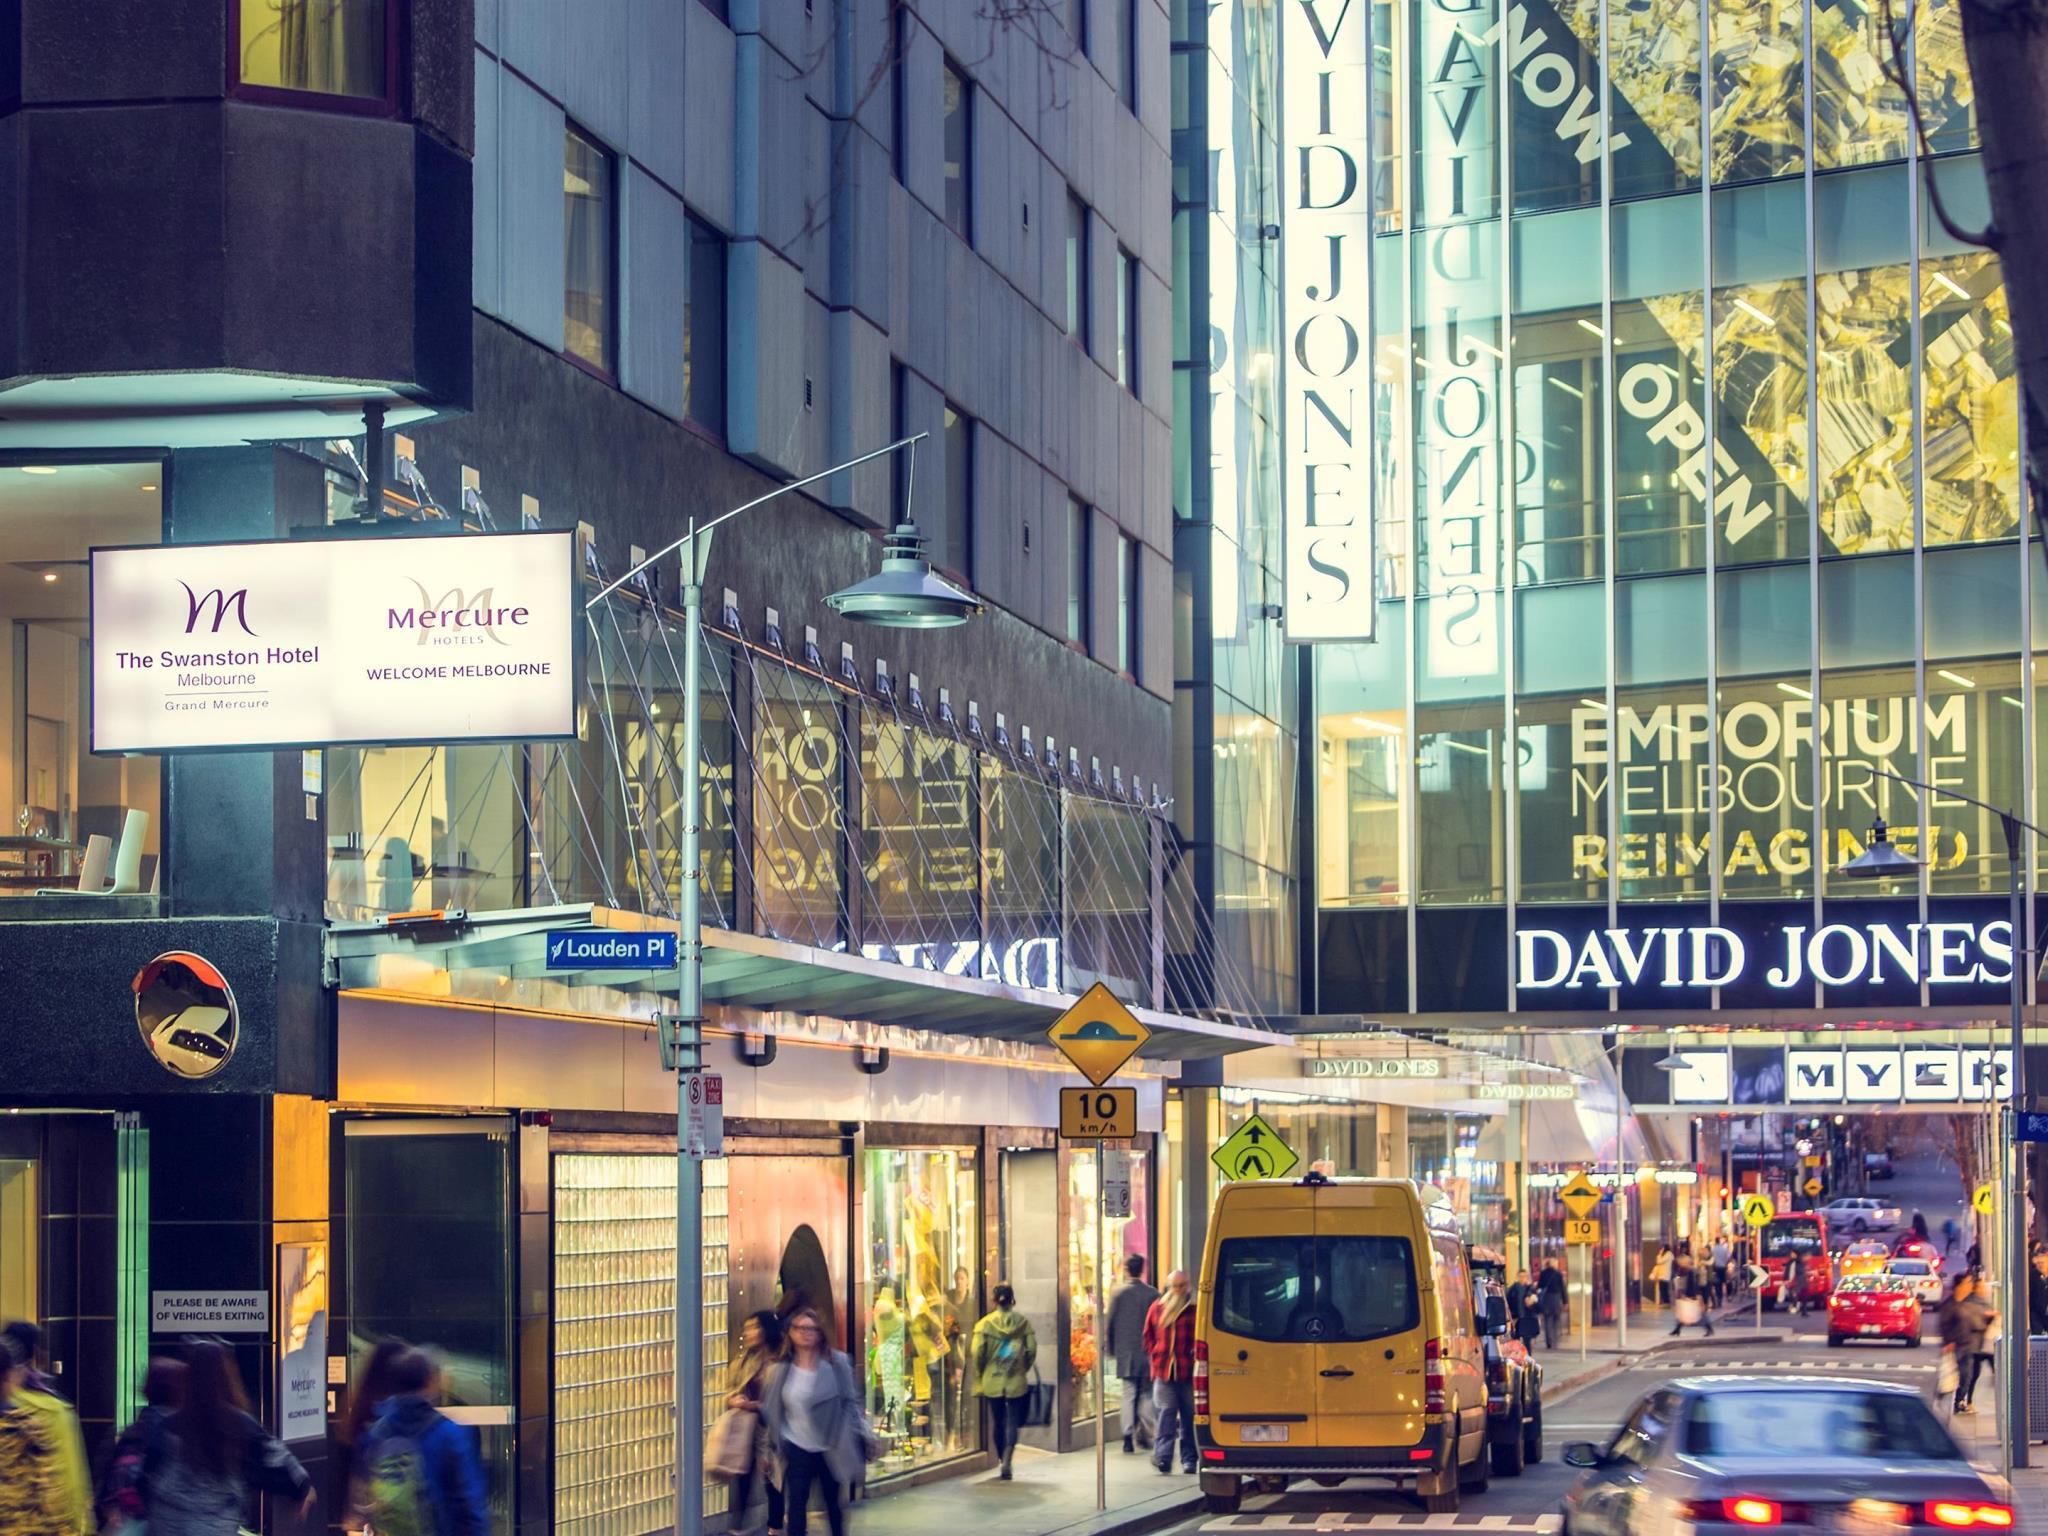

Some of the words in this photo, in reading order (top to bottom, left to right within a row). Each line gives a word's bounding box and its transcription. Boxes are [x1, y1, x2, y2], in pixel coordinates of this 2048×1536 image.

[1483, 3, 1632, 165] NOW
[1294, 235, 1359, 604] JONES
[1618, 362, 1773, 545] OPEN
[387, 606, 529, 629] Mercure
[433, 635, 484, 646] HOTELS
[116, 652, 153, 669] The
[160, 649, 259, 668] Swanston
[266, 646, 319, 664] Hotel
[177, 672, 256, 687] Melbourne
[366, 666, 447, 680] WELCOME
[452, 662, 551, 677] MELBOURNE
[164, 701, 207, 711] Grand
[213, 699, 270, 710] Mercure
[1571, 694, 1967, 764] EMPORIUM
[1571, 756, 1968, 817] MELBOURNE
[567, 939, 640, 958] Louden
[647, 939, 665, 957] Pl
[1515, 926, 1746, 989] DAVID
[1766, 920, 2014, 988] JONES
[1313, 1059, 1372, 1076] DAVID
[1376, 1059, 1440, 1077] JONES
[707, 1079, 721, 1089] TAXI
[1479, 1085, 1523, 1098] DAVID
[1525, 1085, 1574, 1098] JONES
[1079, 1092, 1117, 1119] 10
[1080, 1122, 1117, 1135] km/h
[1574, 1222, 1591, 1234] 10
[163, 1298, 203, 1307] PLEASE
[205, 1298, 218, 1307] BE
[221, 1298, 258, 1307] AWARE
[156, 1311, 170, 1321] OF
[172, 1311, 222, 1321] VEHICLES
[224, 1311, 265, 1321] EXITING
